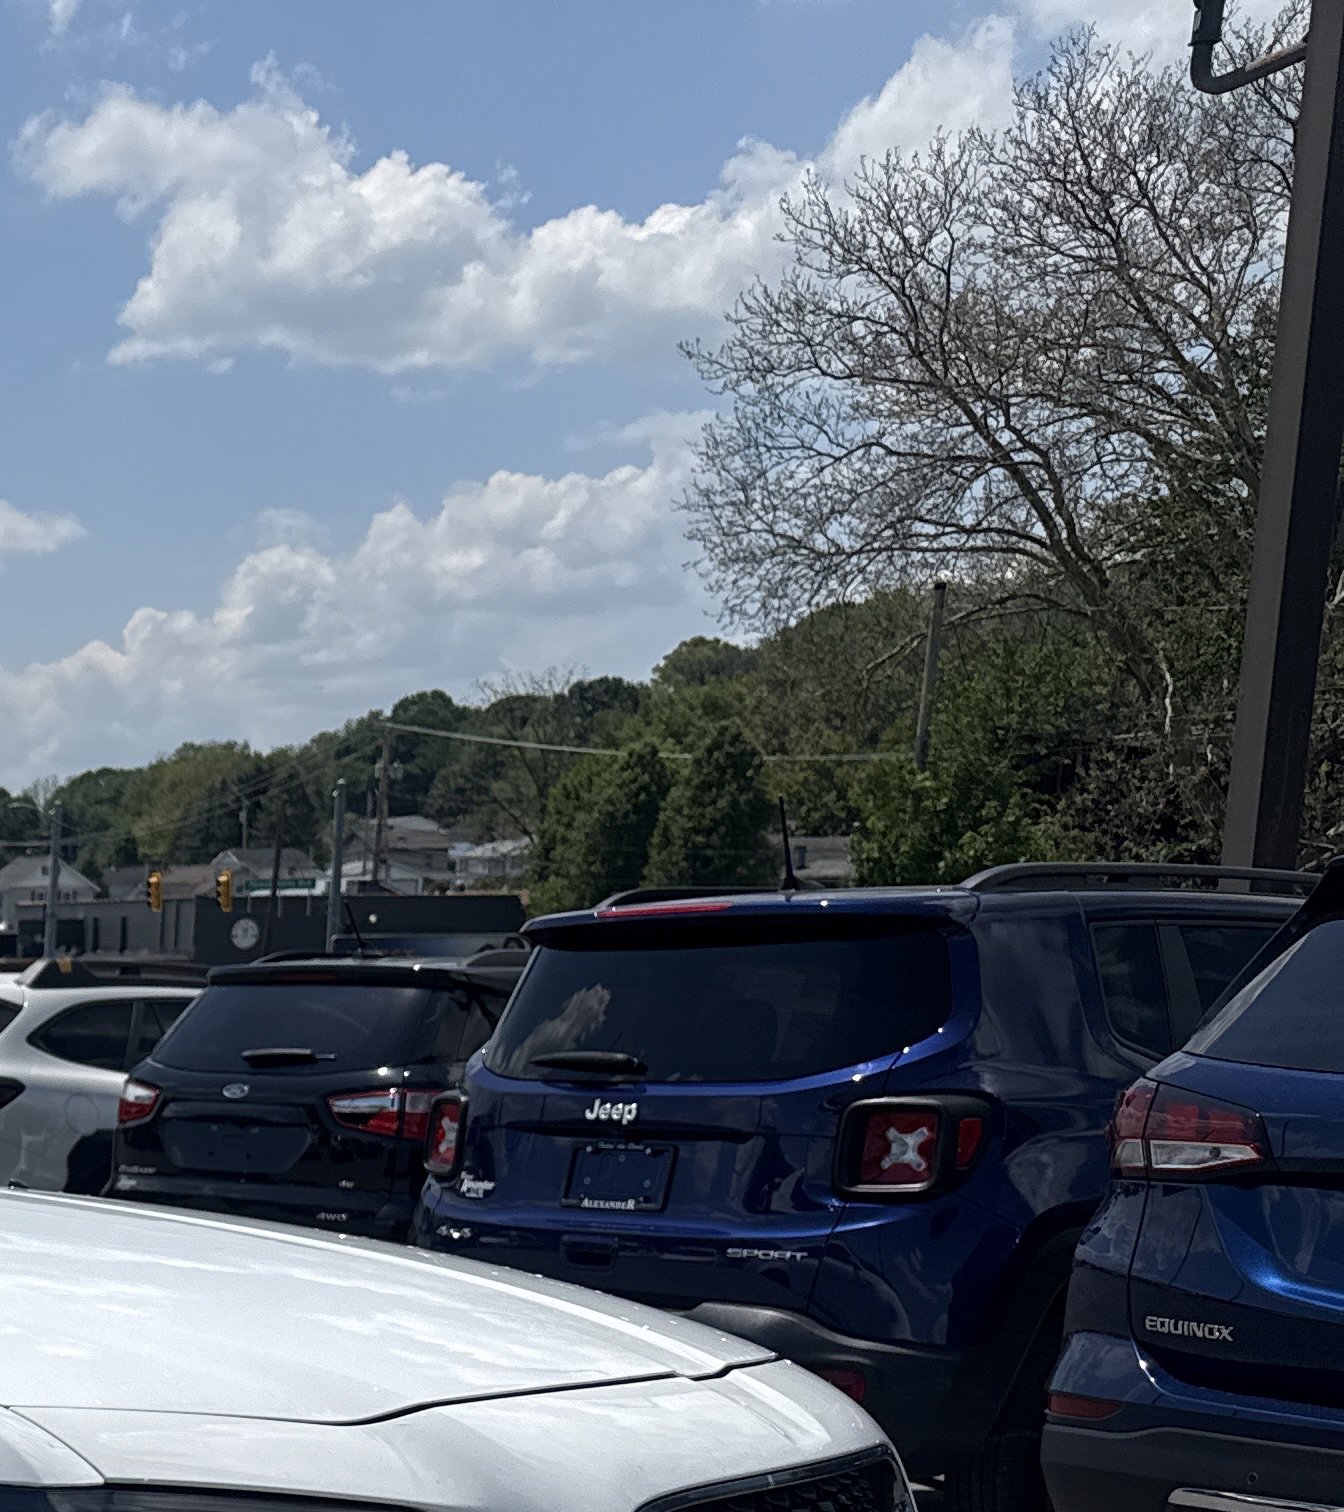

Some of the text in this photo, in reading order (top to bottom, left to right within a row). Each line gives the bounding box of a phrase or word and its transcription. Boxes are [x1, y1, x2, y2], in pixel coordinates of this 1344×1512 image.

[584, 1097, 638, 1126] Jeep
[725, 1247, 809, 1261] SPORT
[1144, 1315, 1234, 1342] EQUINOX
